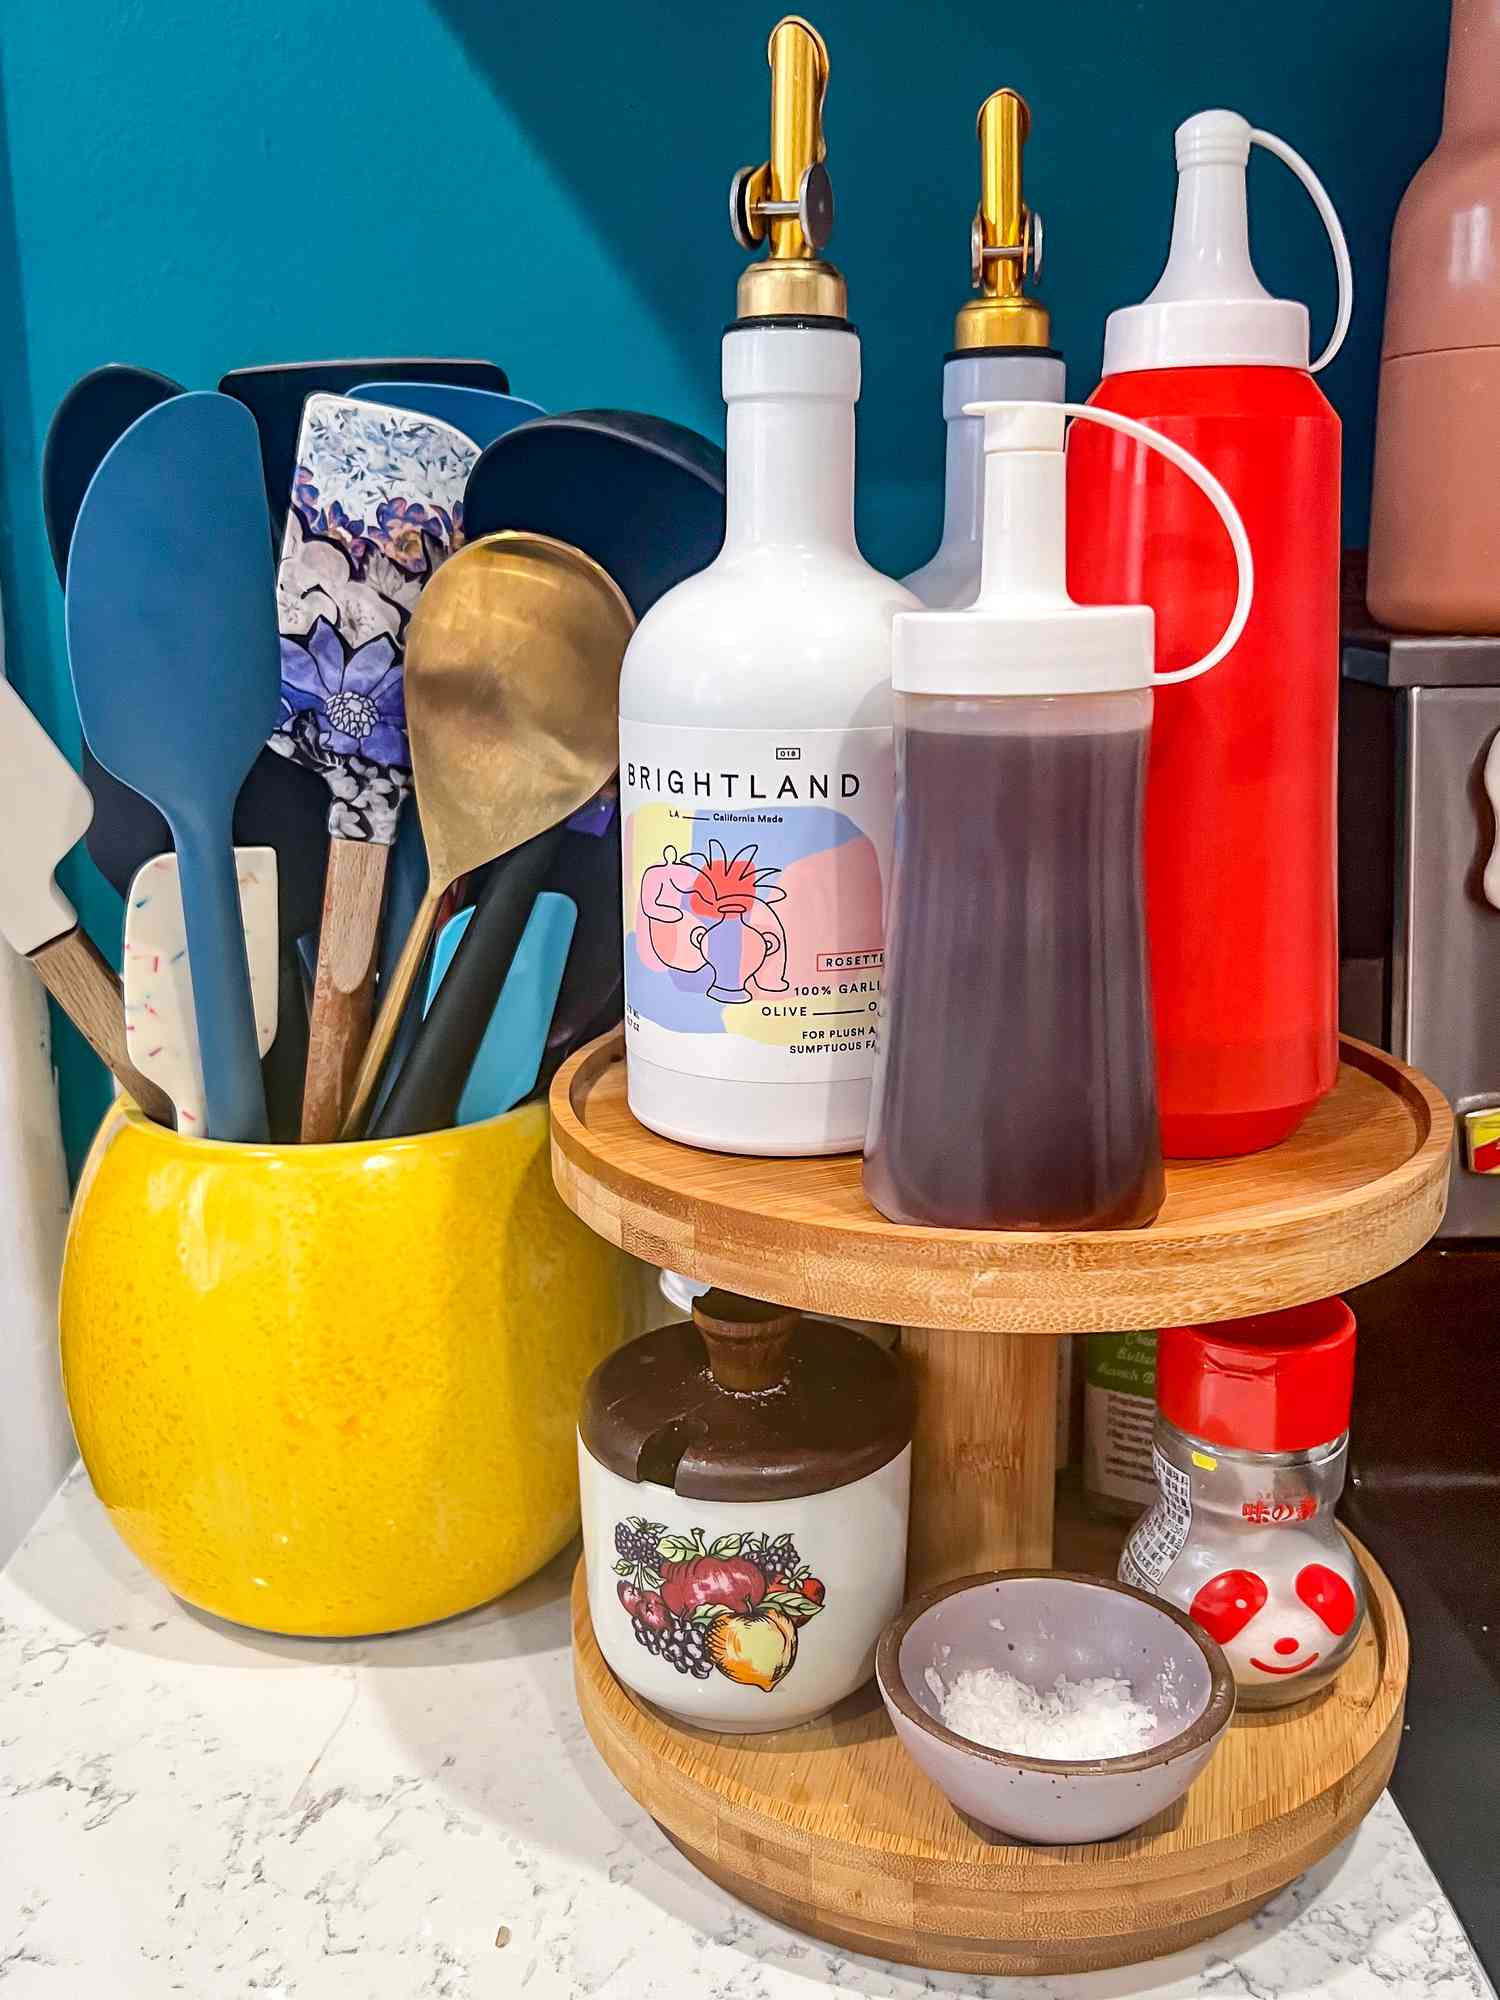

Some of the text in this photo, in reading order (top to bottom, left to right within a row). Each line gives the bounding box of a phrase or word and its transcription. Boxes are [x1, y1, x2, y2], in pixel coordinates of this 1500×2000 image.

[779, 750, 797, 758] 018
[627, 762, 860, 799] BRIGHTLAND
[669, 809, 784, 824] LA California Made
[794, 980, 881, 997] 100% GARLI
[761, 1001, 878, 1017] OLIVE O
[802, 1030, 826, 1040] FOR
[829, 1026, 865, 1038] PLUSH
[789, 1041, 862, 1055] SUMPTUOUS
